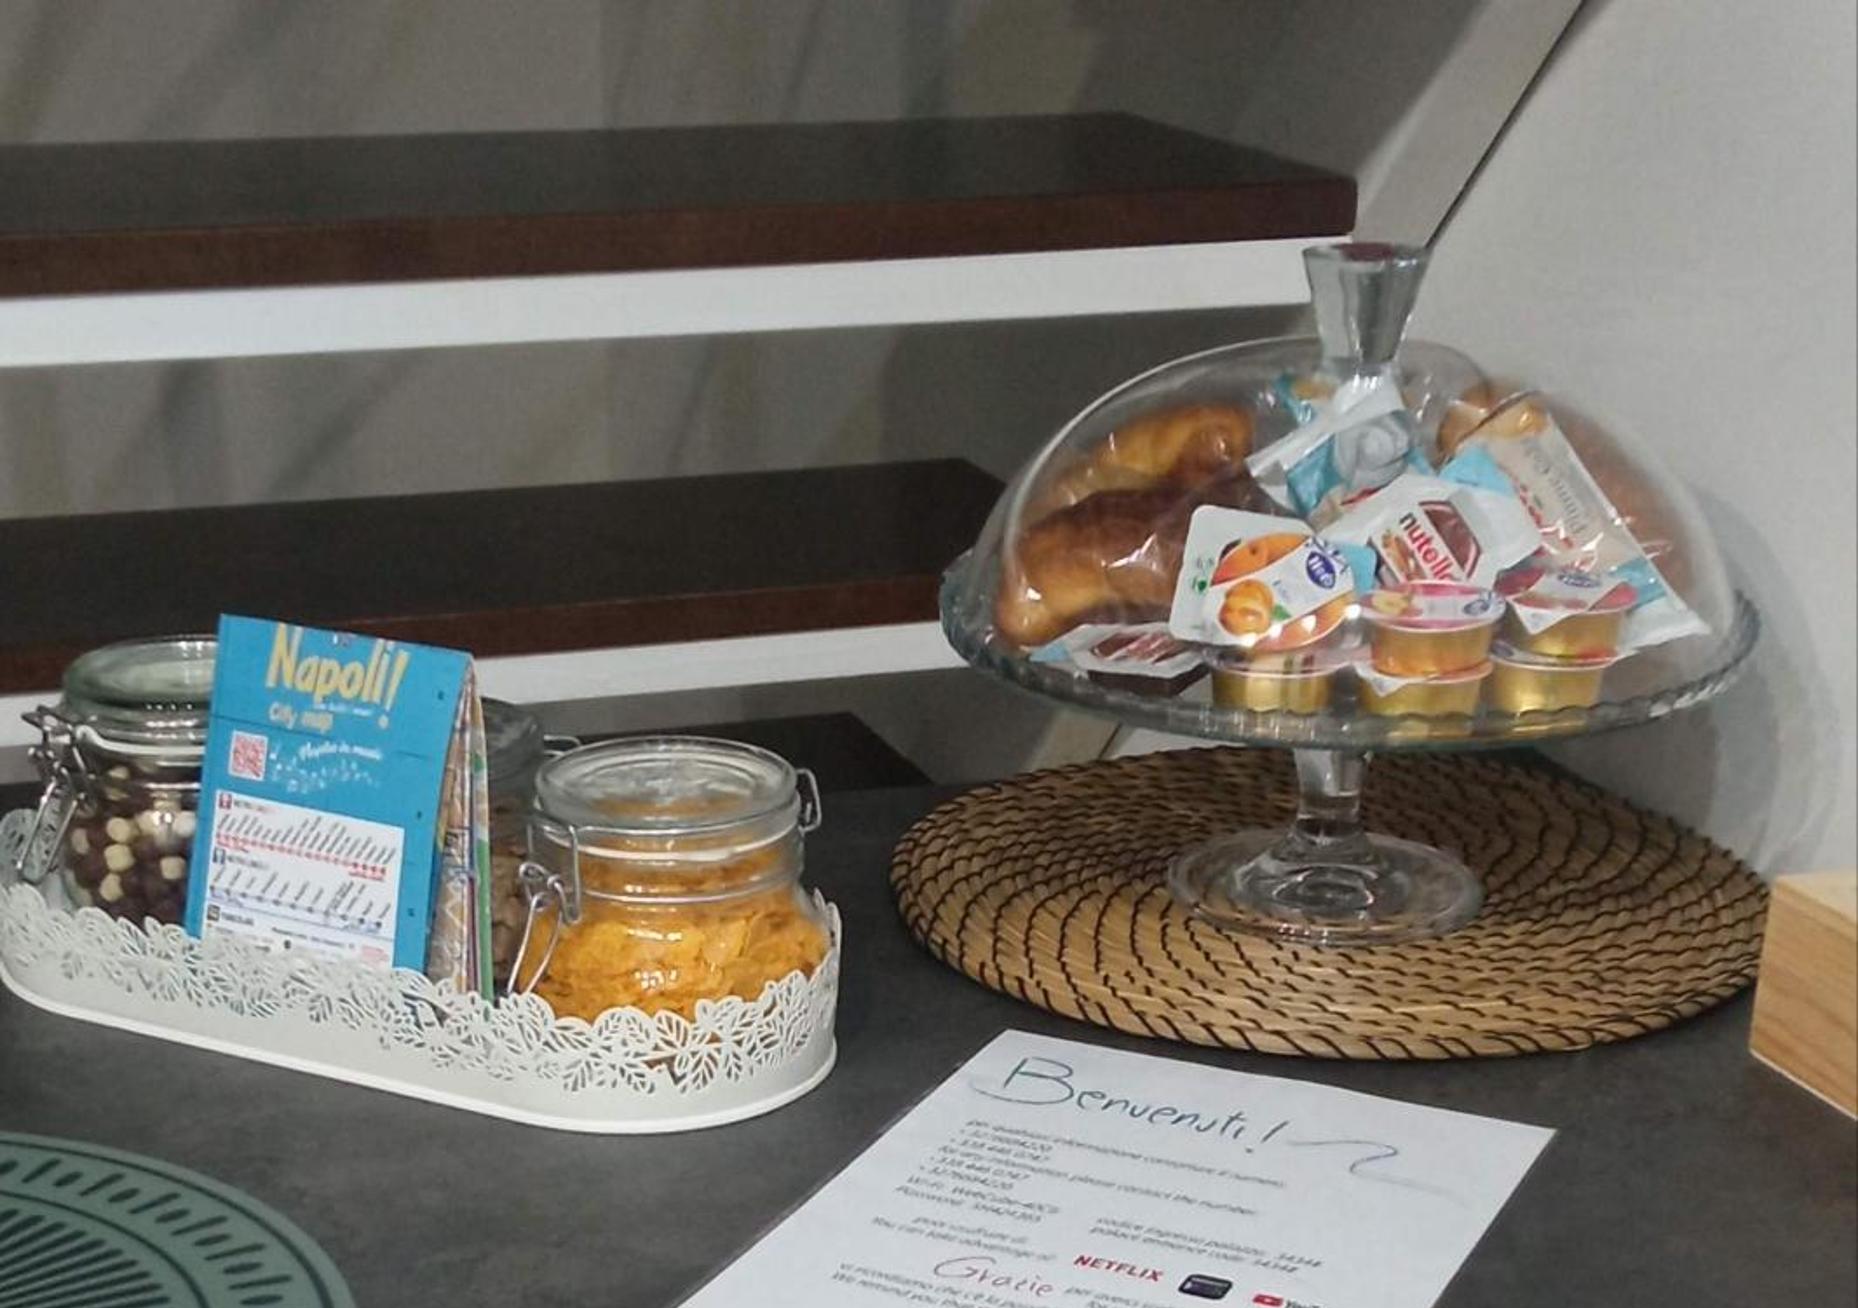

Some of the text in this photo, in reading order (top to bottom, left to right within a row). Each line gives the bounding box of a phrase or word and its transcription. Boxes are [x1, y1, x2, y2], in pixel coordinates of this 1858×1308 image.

[265, 622, 410, 730] Napoli!
[269, 702, 297, 730] City
[971, 1056, 1288, 1154] Benvenuti!
[1074, 1254, 1164, 1282] NETFLIX
